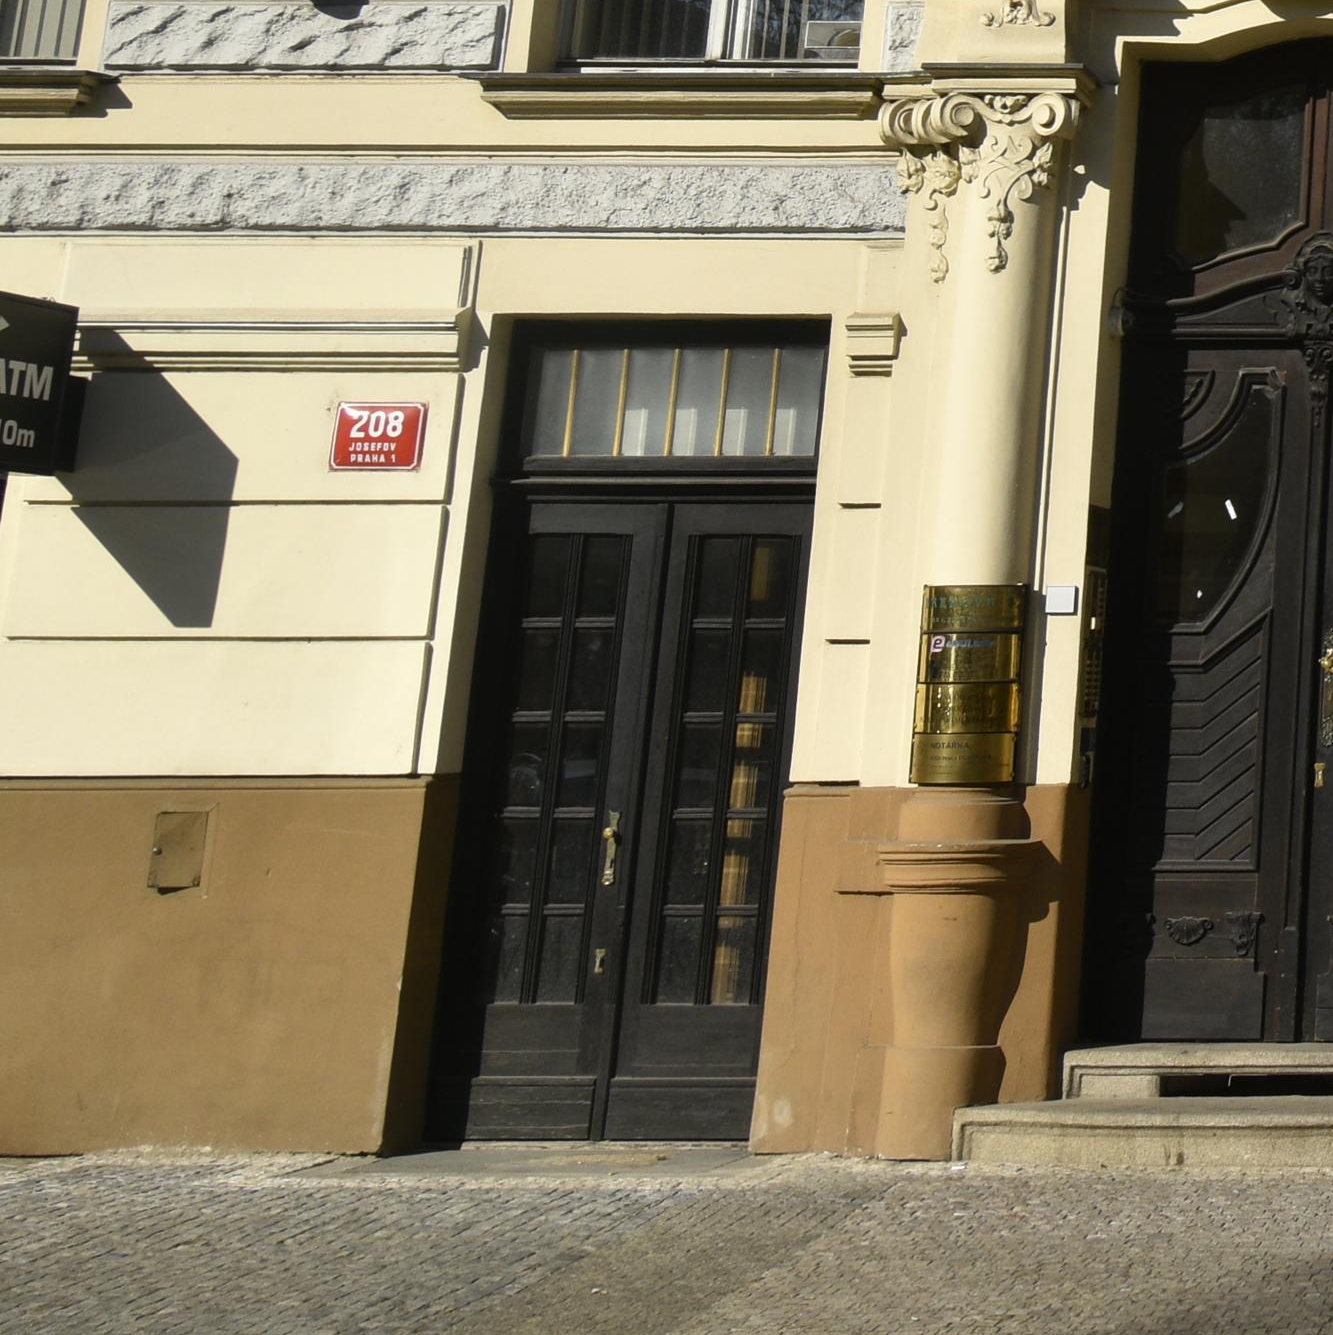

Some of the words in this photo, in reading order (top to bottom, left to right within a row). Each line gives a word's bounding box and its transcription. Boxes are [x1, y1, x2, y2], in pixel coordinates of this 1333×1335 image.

[0, 418, 35, 449] 0m
[349, 410, 405, 438] 208
[348, 441, 396, 452] JOSEFOV
[350, 453, 386, 463] PRAHA
[391, 453, 396, 463] 1
